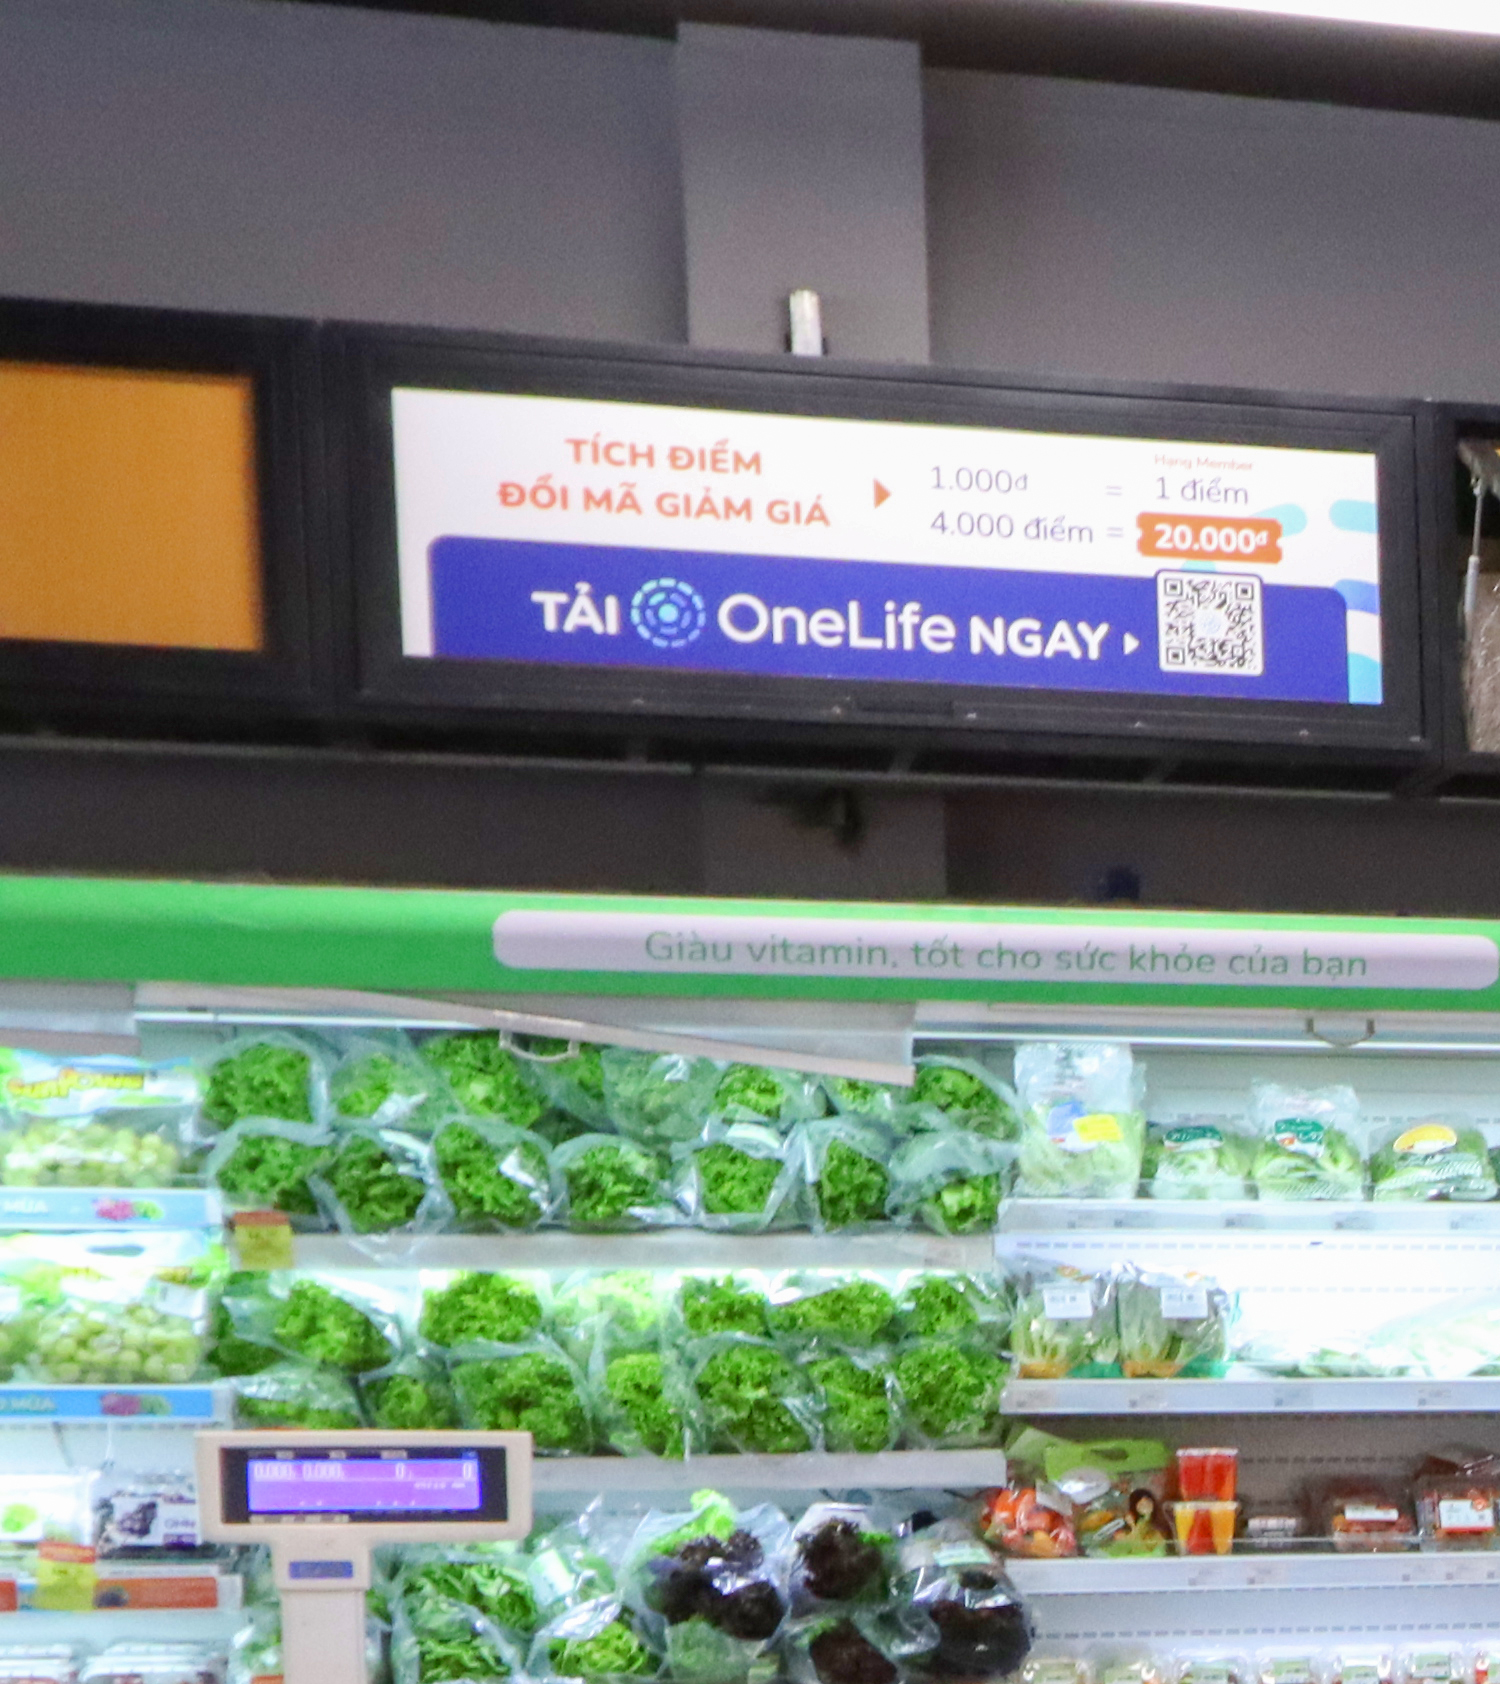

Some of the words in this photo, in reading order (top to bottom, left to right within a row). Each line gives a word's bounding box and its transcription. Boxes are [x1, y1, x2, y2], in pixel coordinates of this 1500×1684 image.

[565, 432, 655, 468] TÍCH
[667, 439, 762, 475] ĐIỂM
[497, 474, 569, 510] ĐỔI
[583, 482, 642, 515] MÃ
[656, 487, 753, 522] GIẢM
[766, 495, 830, 527] GIÁ
[1156, 477, 1170, 500] 1
[1180, 477, 1248, 504] điểm
[931, 510, 1014, 539] 4.000
[1024, 514, 1093, 543] điểm
[531, 582, 620, 635] TẢI
[718, 593, 956, 651] OneLife
[969, 616, 1110, 660] NGAY
[644, 930, 733, 964] Giàu
[746, 934, 900, 968] vitamin,
[909, 938, 961, 970] tốt
[976, 941, 1043, 971] cho
[1056, 942, 1117, 973] sức
[1128, 945, 1217, 975] khỏe
[1227, 945, 1290, 977] của
[1301, 950, 1368, 979] bạn
